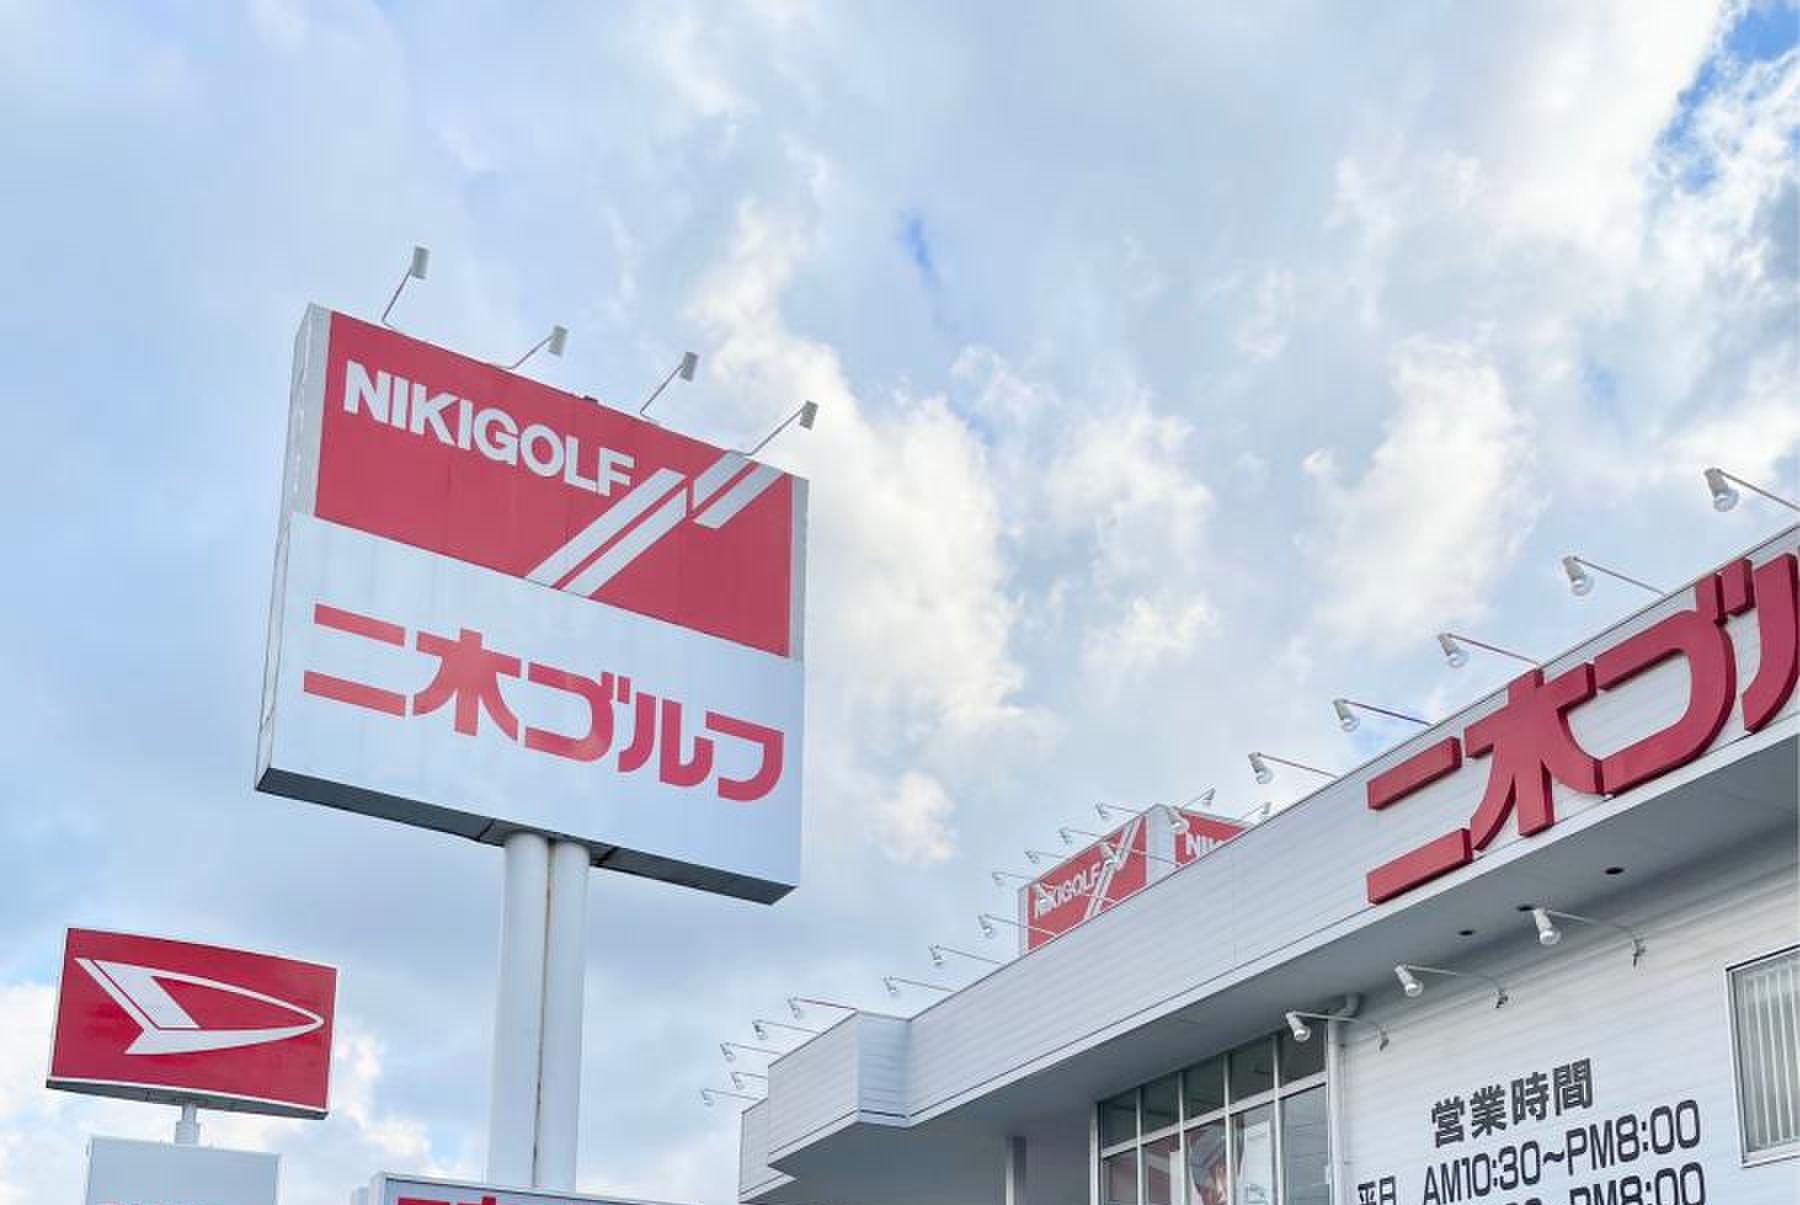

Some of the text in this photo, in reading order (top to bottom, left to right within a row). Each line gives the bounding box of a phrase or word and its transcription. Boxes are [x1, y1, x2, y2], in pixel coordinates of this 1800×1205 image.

[343, 358, 634, 498] NIKIGOLF
[303, 602, 785, 803] 二木ゴルフ
[1034, 861, 1102, 921] NKIGOLF
[1431, 1058, 1593, 1148] 営業時間
